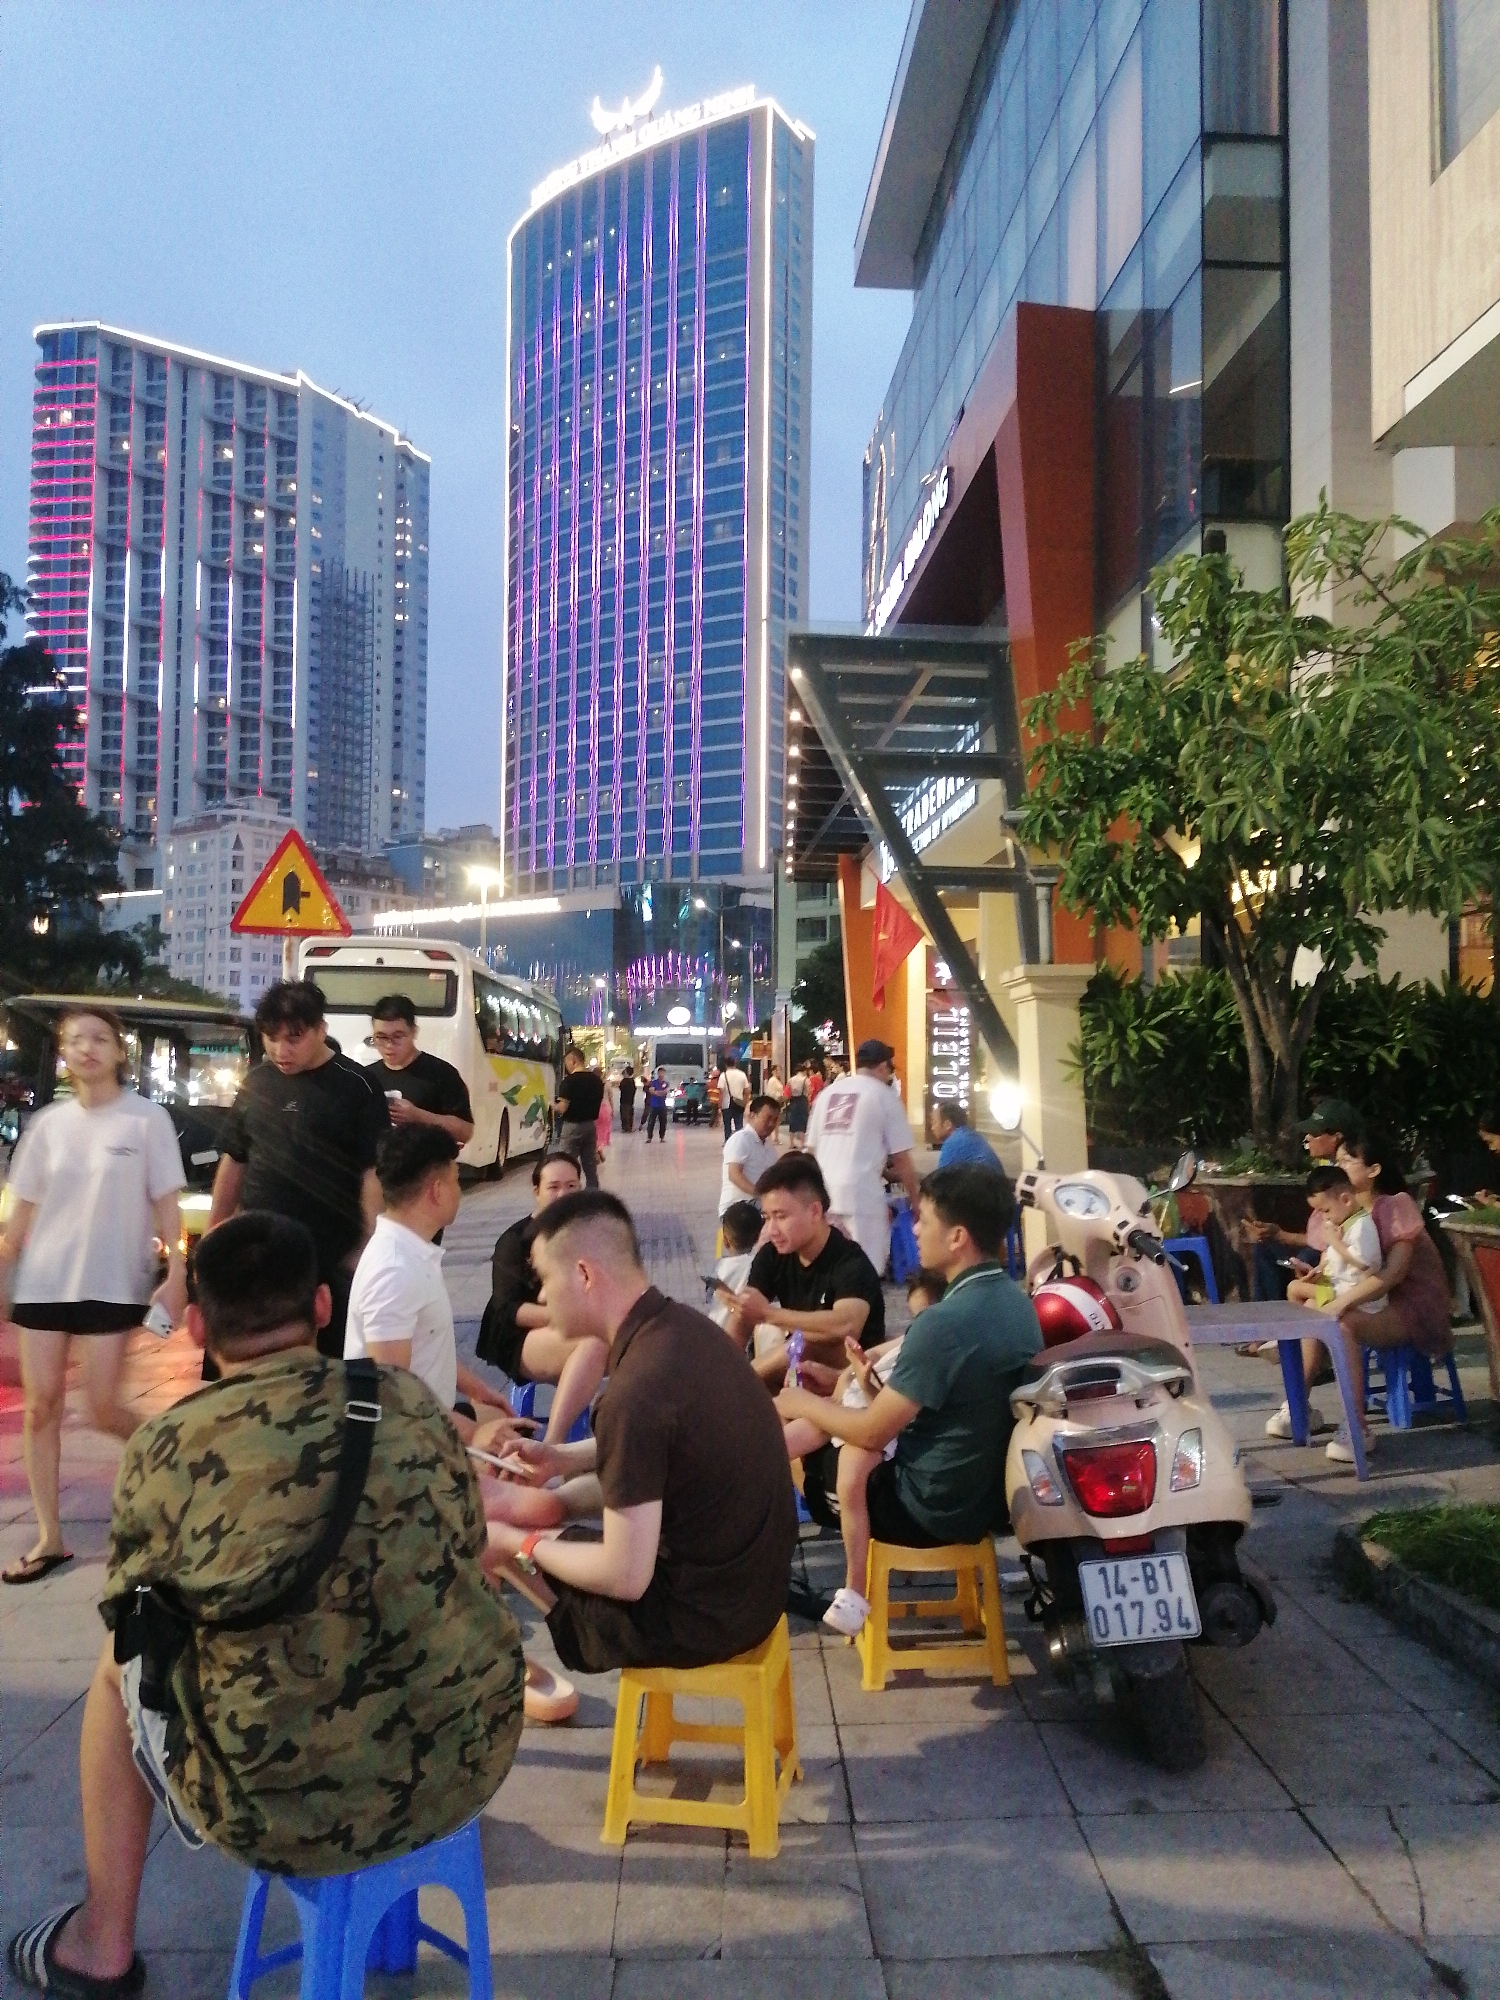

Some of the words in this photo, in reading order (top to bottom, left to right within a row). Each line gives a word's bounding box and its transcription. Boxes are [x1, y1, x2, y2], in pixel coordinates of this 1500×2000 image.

[933, 1006, 960, 1109] OLEIL
[1098, 1560, 1173, 1599] 14-B1
[1093, 1597, 1191, 1638] 017.94
